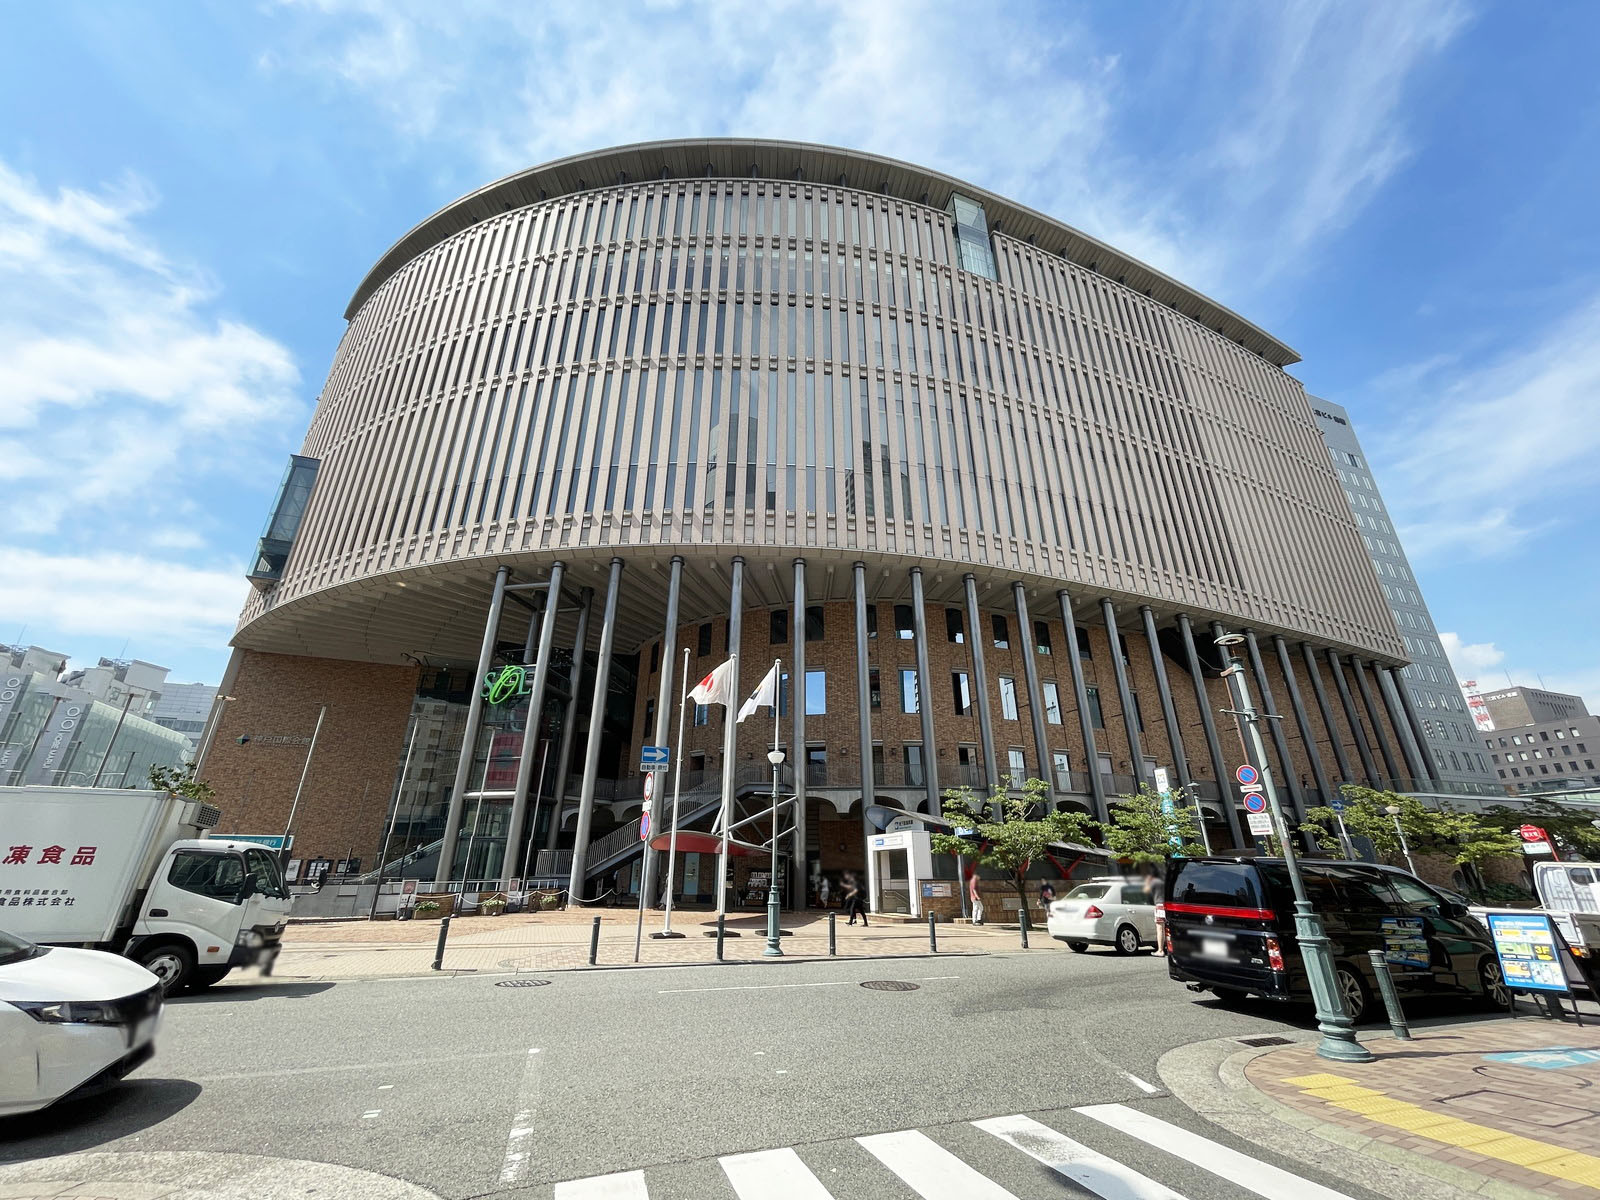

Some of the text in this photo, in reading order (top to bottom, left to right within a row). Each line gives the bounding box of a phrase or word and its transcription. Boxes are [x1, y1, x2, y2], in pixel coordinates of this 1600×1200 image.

[2, 844, 97, 866] 凍食品
[0, 896, 76, 907] 食品株式会社
[1534, 945, 1550, 955] 3F
